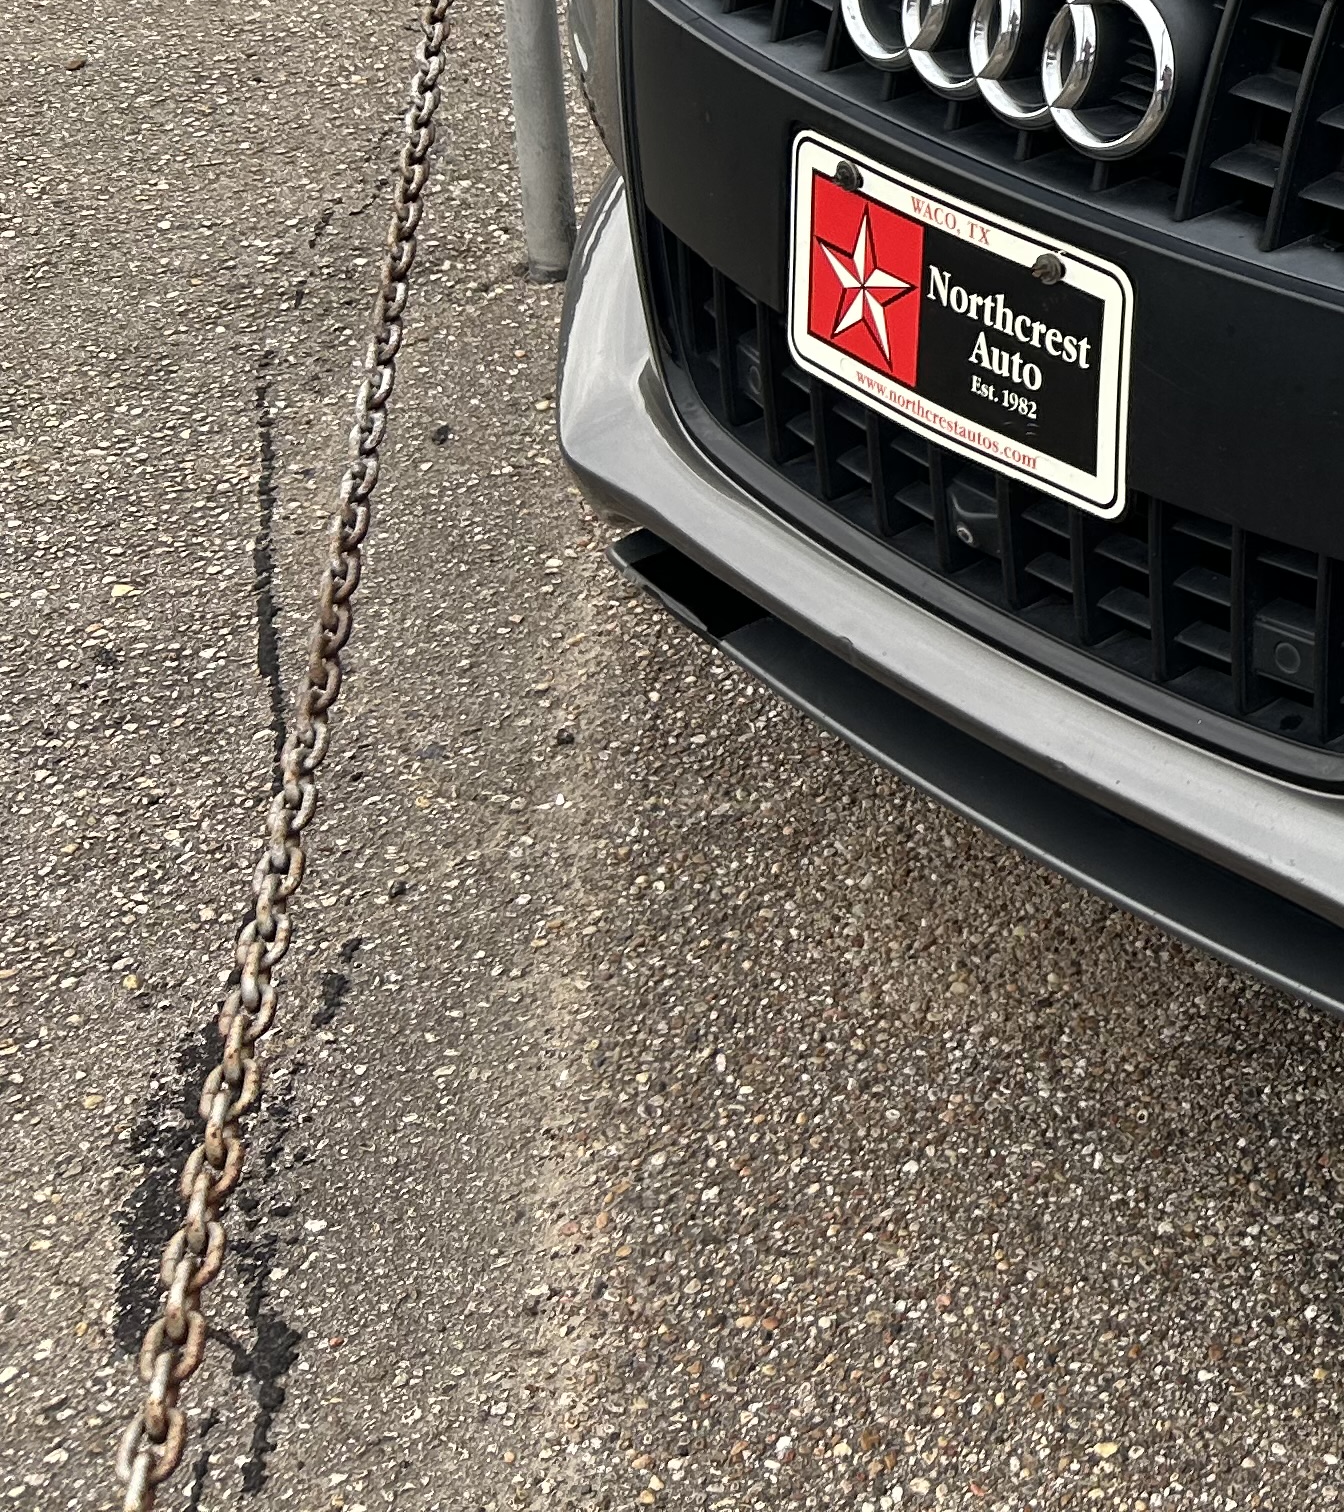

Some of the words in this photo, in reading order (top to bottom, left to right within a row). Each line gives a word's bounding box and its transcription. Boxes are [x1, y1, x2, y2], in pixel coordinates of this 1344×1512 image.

[910, 195, 961, 236] WACO,
[967, 220, 991, 246] TX
[926, 264, 1092, 370] Northcrest
[968, 331, 1043, 391] Auto
[855, 370, 1038, 471] www.northcrestautos.com
[970, 374, 999, 403] Est.
[1002, 389, 1037, 420] 1982
